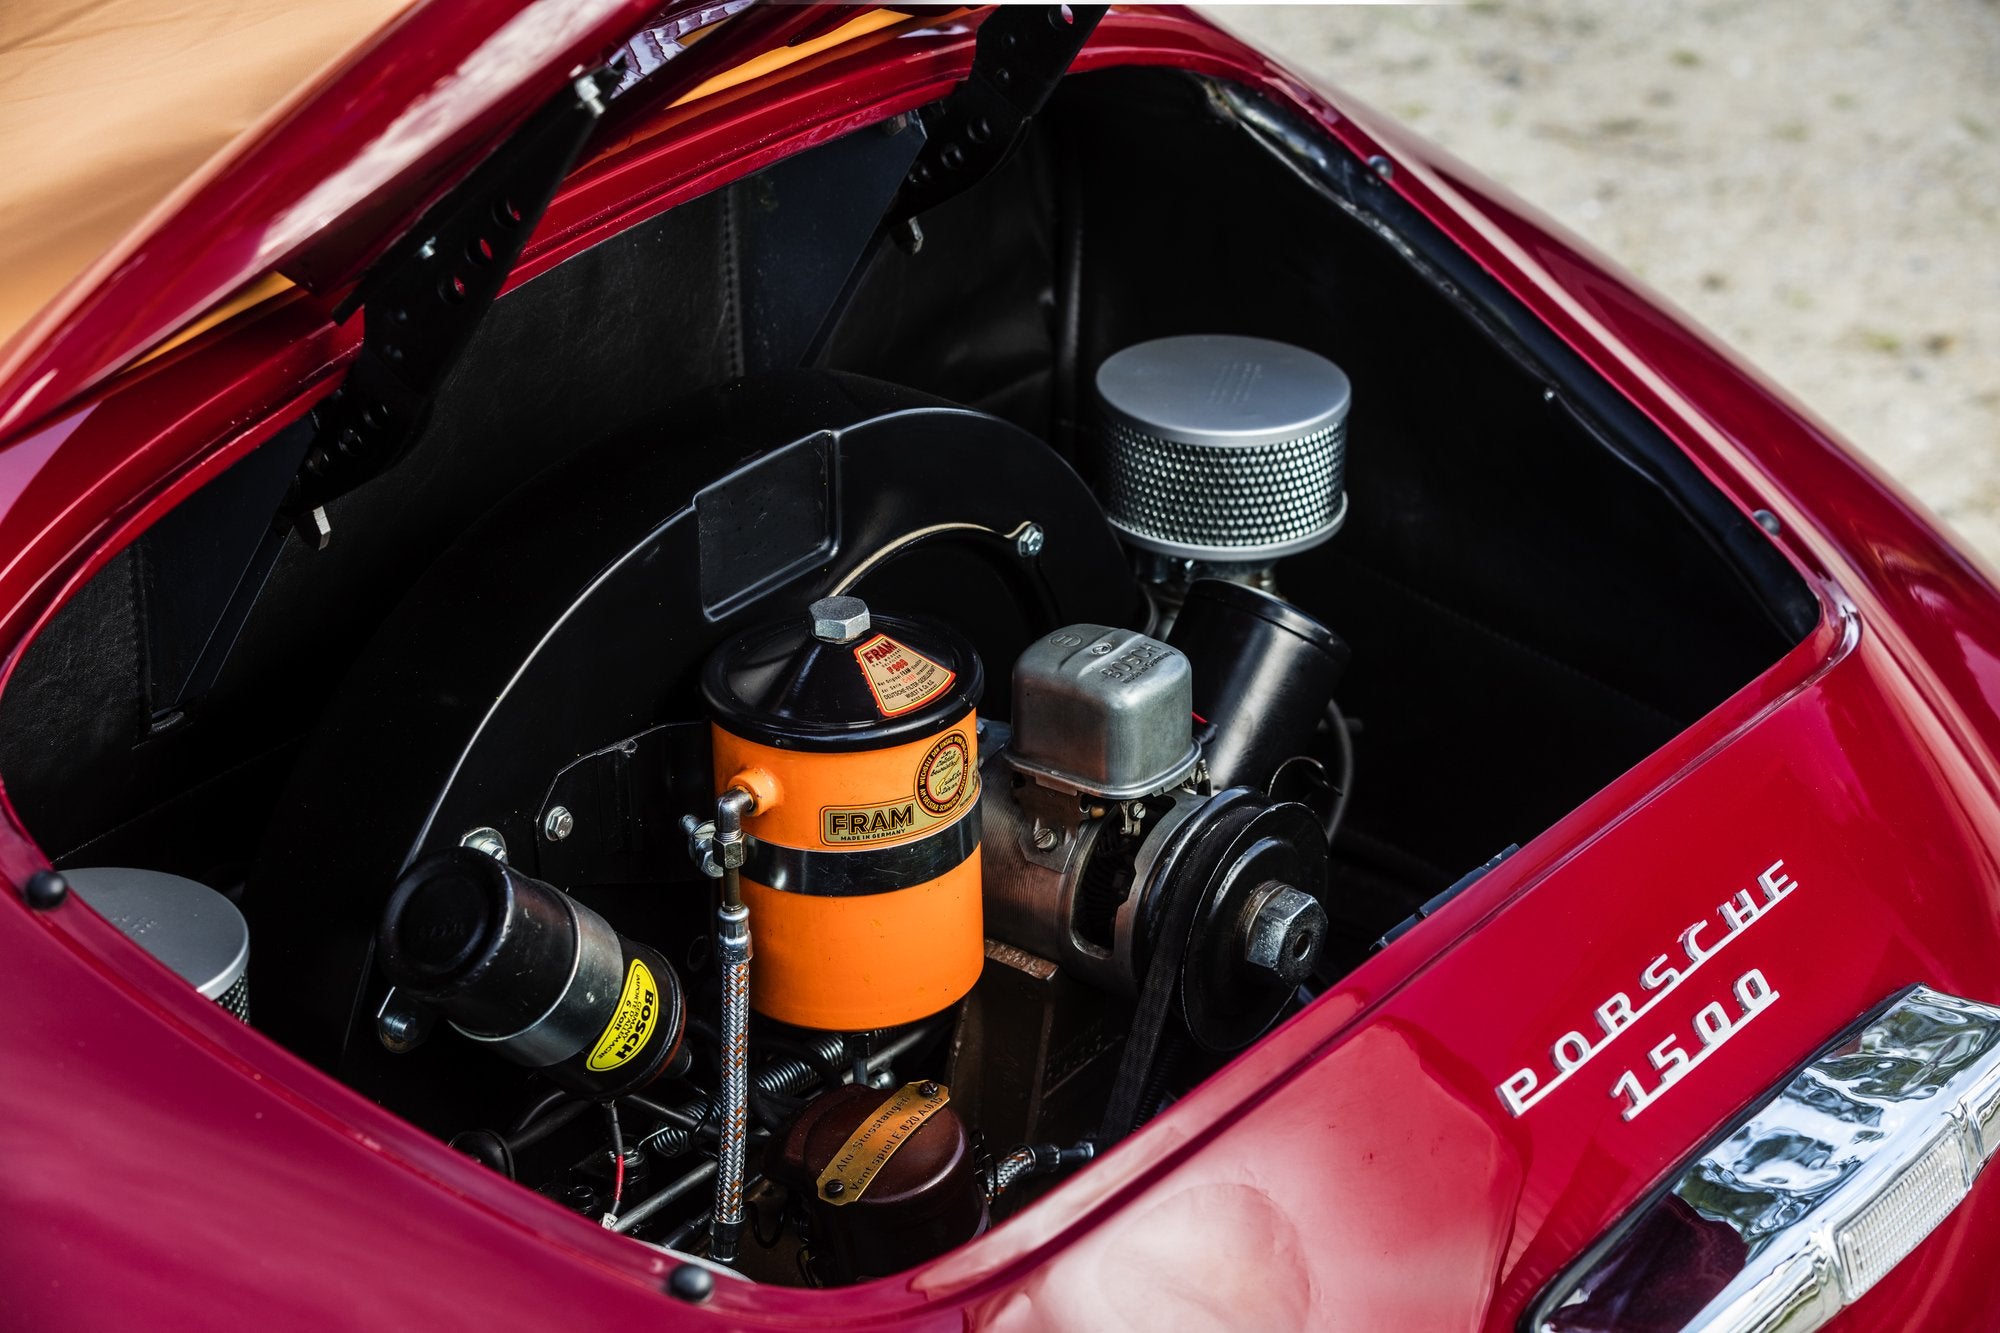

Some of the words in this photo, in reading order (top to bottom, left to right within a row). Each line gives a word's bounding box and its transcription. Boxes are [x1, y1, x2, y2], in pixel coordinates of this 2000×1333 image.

[863, 639, 898, 664] FRAM
[1100, 643, 1161, 679] BOSCH
[830, 803, 914, 836] FRAM
[840, 834, 862, 842] MADE
[872, 828, 907, 840] GERMANY
[626, 999, 632, 1008] 6
[1494, 858, 1799, 1118] PORSCHE
[616, 989, 654, 1060] BOSCH
[622, 1001, 642, 1041] GERMANY
[1609, 967, 1781, 1122] 1500
